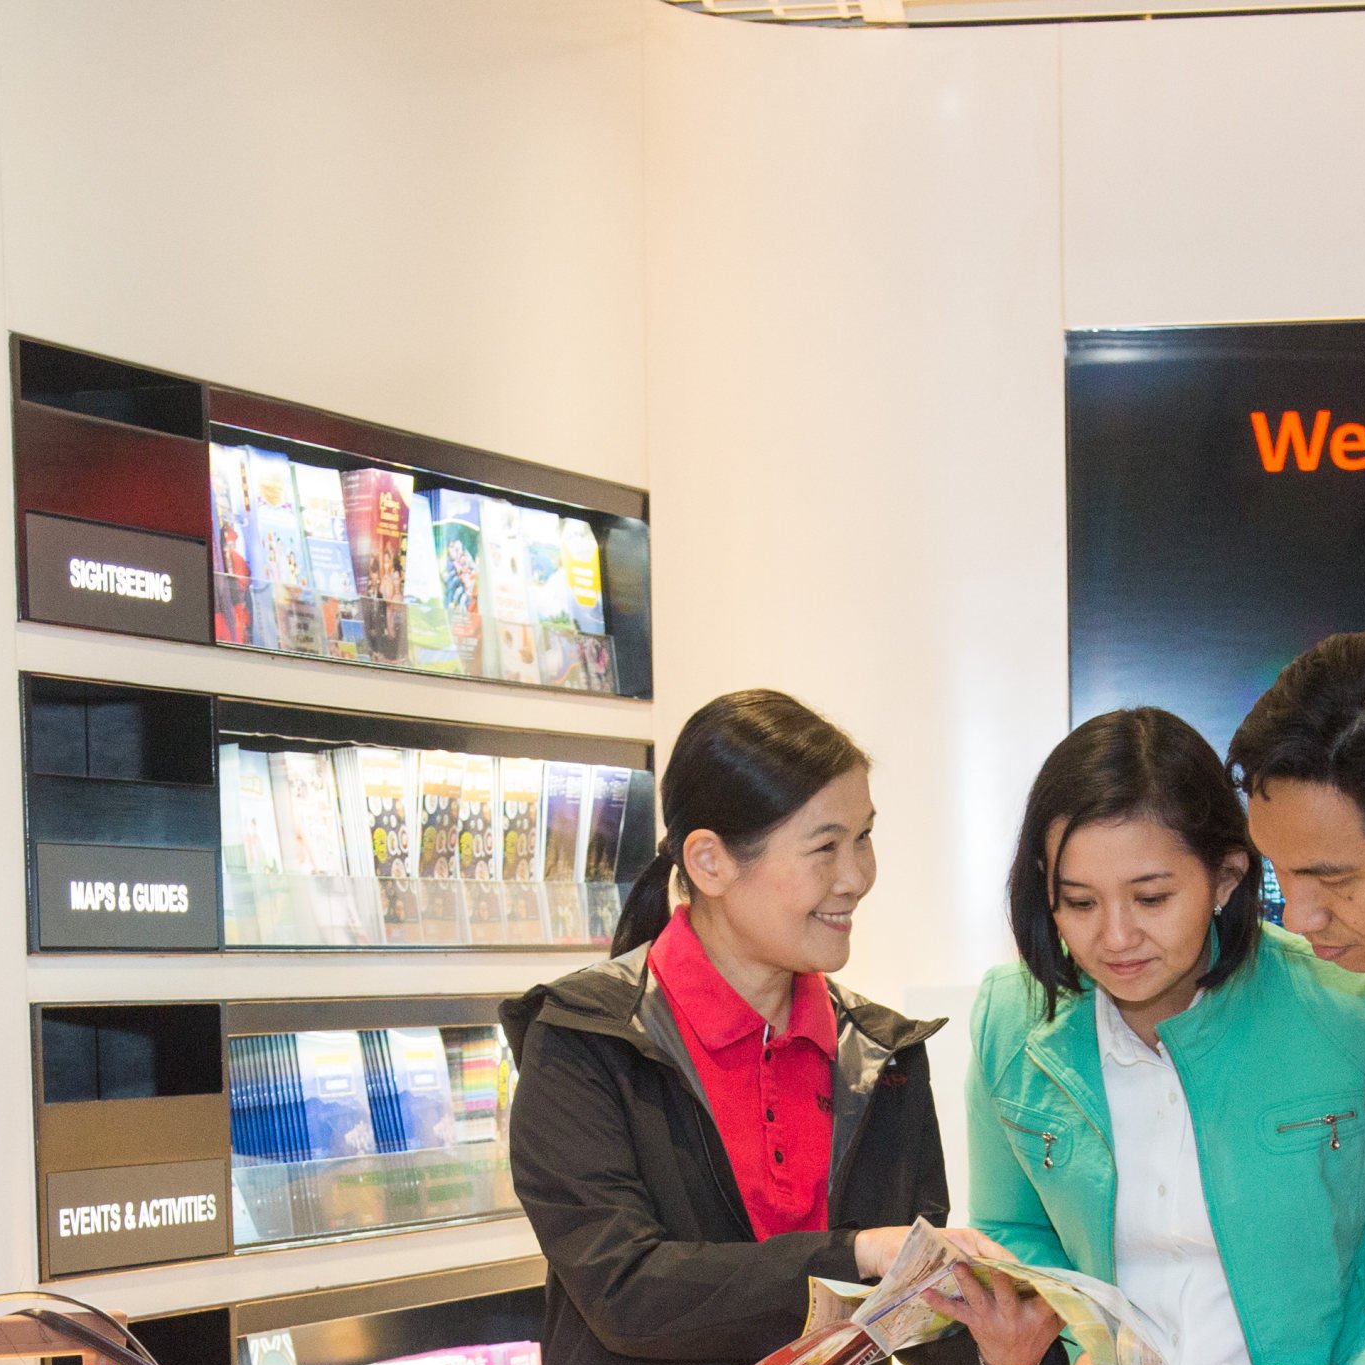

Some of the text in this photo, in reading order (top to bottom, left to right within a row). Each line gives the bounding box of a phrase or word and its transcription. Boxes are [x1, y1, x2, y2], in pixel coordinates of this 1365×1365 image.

[69, 557, 173, 603] SIGHTSEEING
[70, 880, 189, 914] MAPS & GUIDES
[58, 1194, 217, 1238] EVENTS & ACTIVITIES
